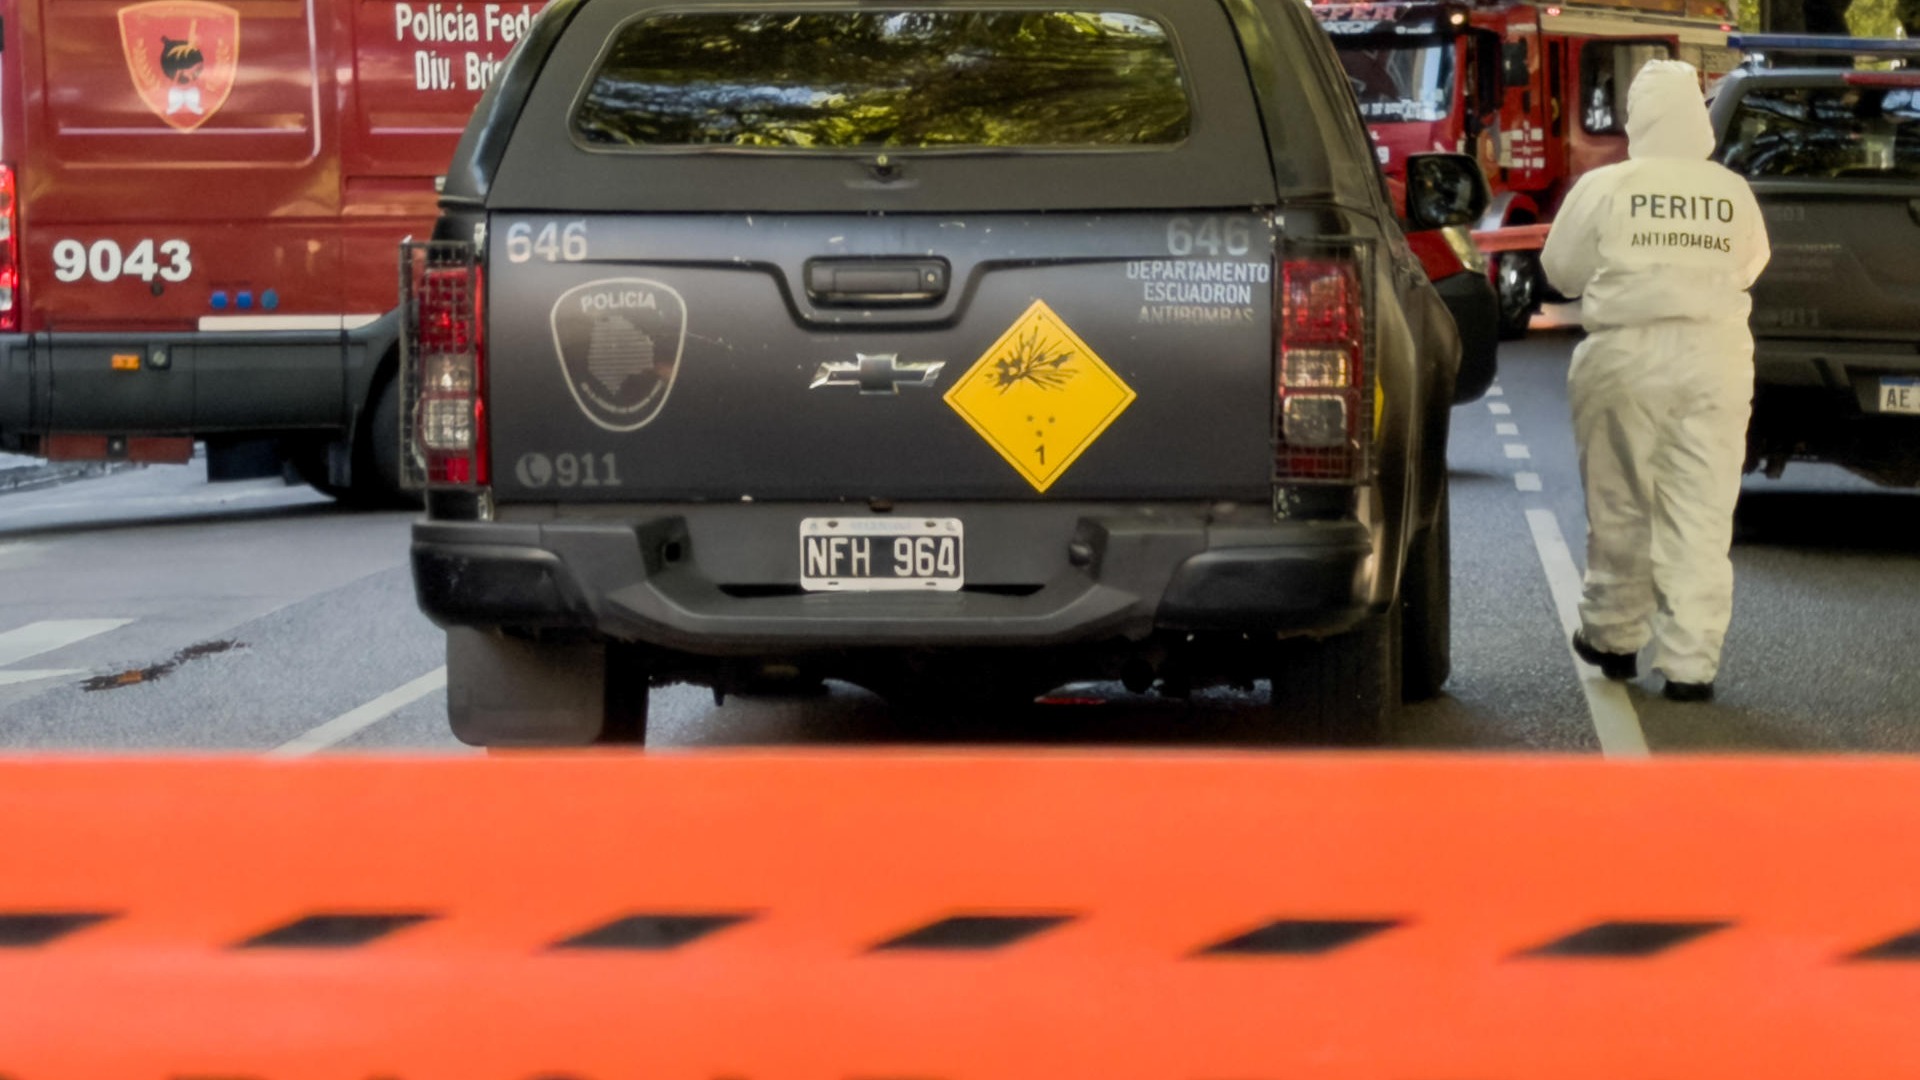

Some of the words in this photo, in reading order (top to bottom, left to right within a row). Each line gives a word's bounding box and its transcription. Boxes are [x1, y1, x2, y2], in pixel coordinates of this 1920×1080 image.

[395, 3, 479, 42] Policia
[485, 4, 539, 42] Fed
[415, 50, 456, 91] Div.
[1630, 194, 1734, 223] PERITO
[506, 220, 588, 263] 646
[1167, 216, 1249, 256] 646
[1631, 231, 1731, 253] ANTIBOMBAS
[52, 238, 193, 282] 9043
[1126, 260, 1270, 283] DEPARTAMENTO
[580, 291, 656, 313] POLICIA
[1143, 282, 1251, 304] ESCUADRON
[1886, 388, 1911, 408] AE
[556, 452, 621, 487] 911
[1035, 444, 1045, 465] 1
[808, 537, 870, 576] NFH
[894, 537, 955, 576] 964
